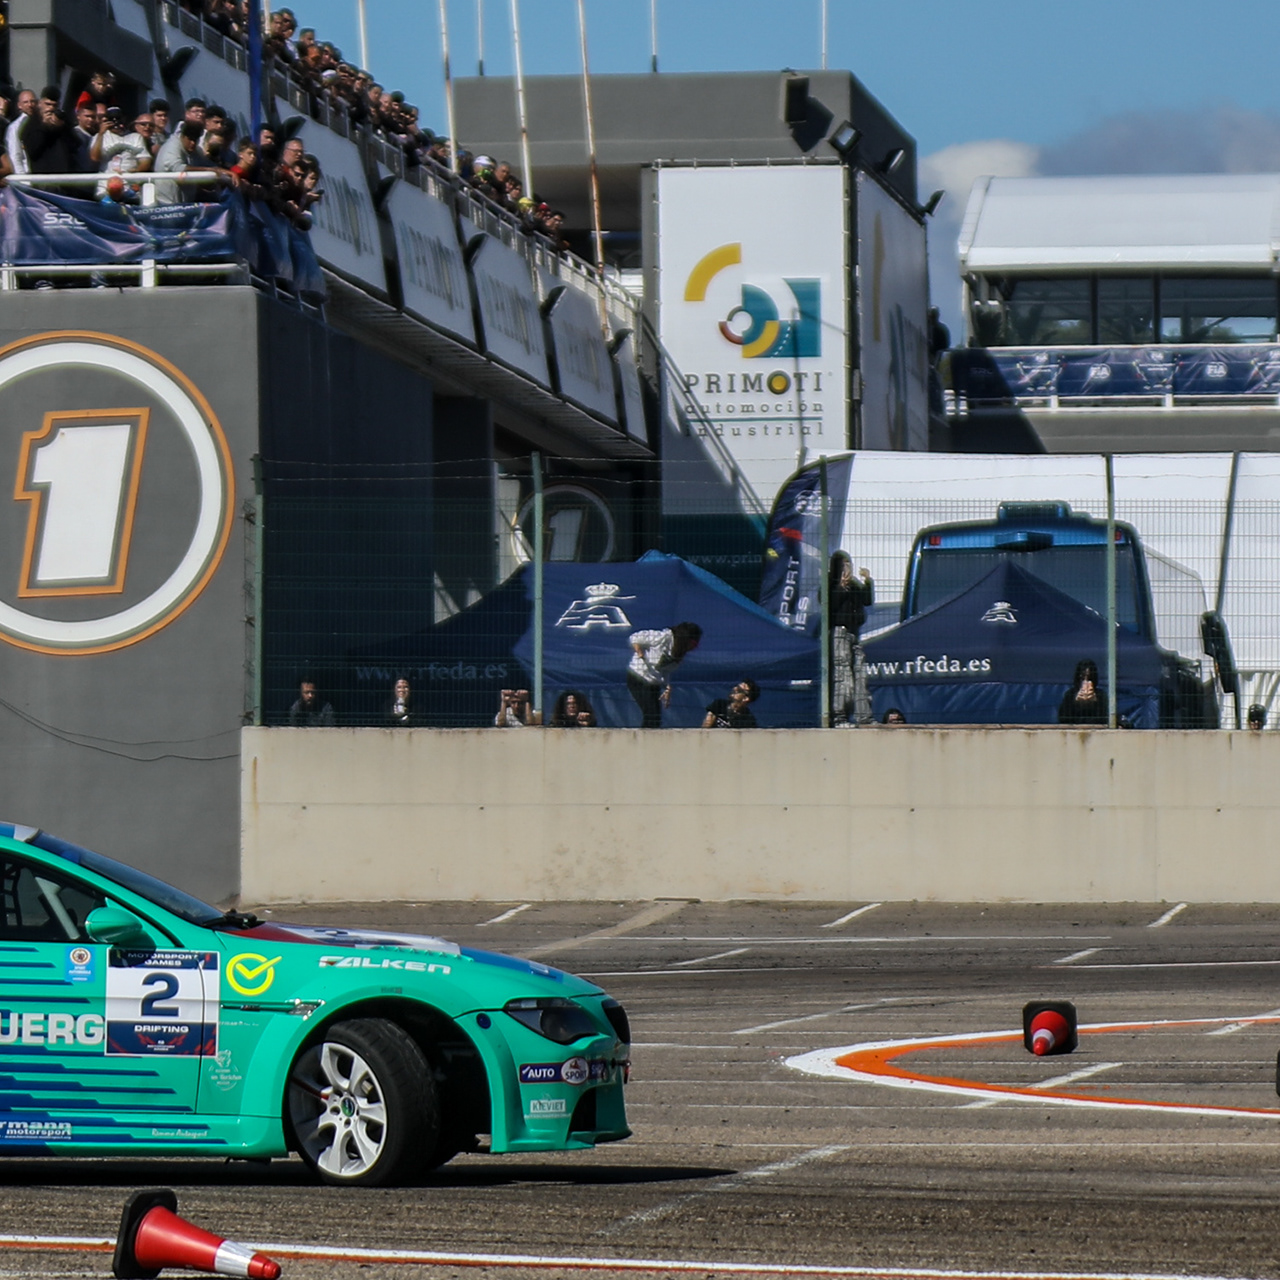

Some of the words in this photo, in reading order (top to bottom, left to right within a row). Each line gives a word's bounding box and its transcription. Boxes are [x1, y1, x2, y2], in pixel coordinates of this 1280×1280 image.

[684, 371, 823, 395] PRIMOTI
[685, 400, 823, 414] automoción
[685, 422, 823, 437] industrial
[20, 413, 143, 591] 1
[865, 654, 991, 675] ww.rfeda.es
[318, 955, 451, 975] FALKEN
[141, 972, 180, 1017] 2
[134, 1024, 189, 1033] DRIFTING
[527, 1067, 555, 1079] AUTO
[565, 1070, 587, 1080] SPORT
[6, 1128, 71, 1137] motorsport
